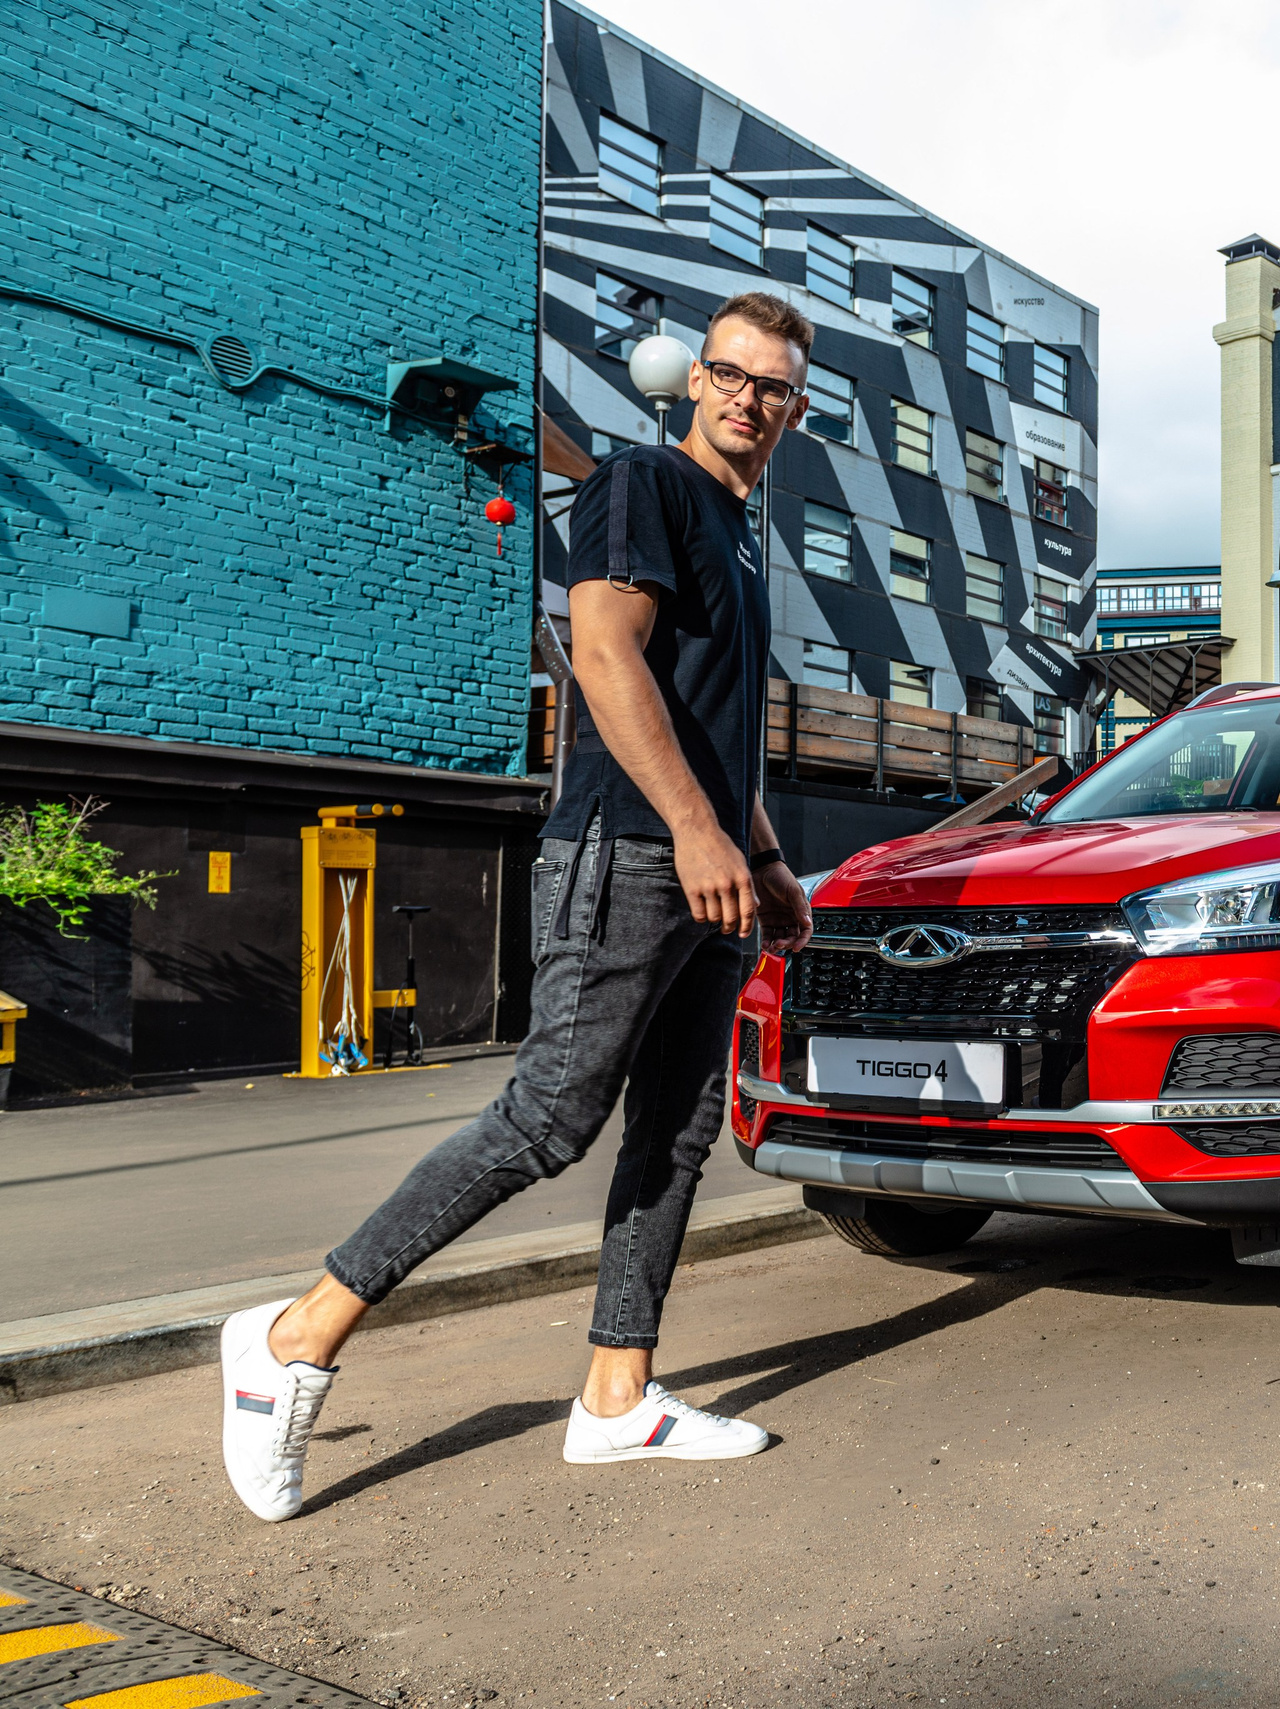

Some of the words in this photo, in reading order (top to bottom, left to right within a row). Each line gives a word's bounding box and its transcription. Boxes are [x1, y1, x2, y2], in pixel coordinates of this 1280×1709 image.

[1013, 297, 1045, 307] искусство
[1025, 430, 1066, 452] образование
[1044, 538, 1072, 556] культура
[1025, 642, 1063, 677] архитектура
